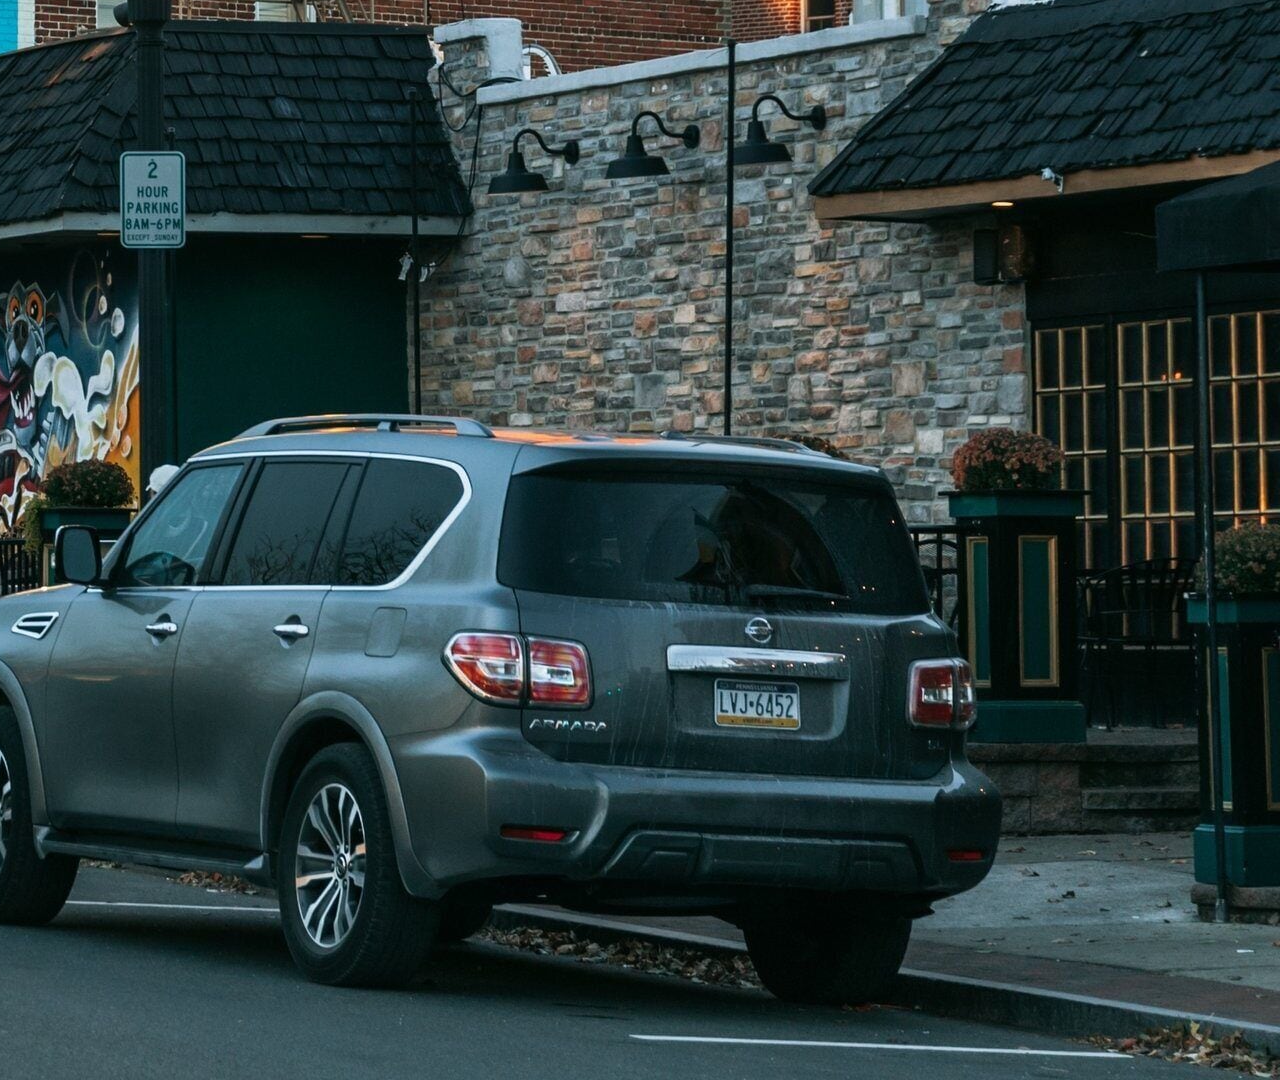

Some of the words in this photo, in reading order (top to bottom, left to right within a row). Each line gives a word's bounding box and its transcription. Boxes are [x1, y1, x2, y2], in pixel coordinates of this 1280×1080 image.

[147, 161, 158, 179] 2
[137, 185, 169, 198] HOUR
[126, 201, 180, 214] PARKING
[125, 217, 182, 231] 8AM-6PM
[126, 233, 151, 241] EXCEPT
[154, 233, 178, 241] SUNDAY
